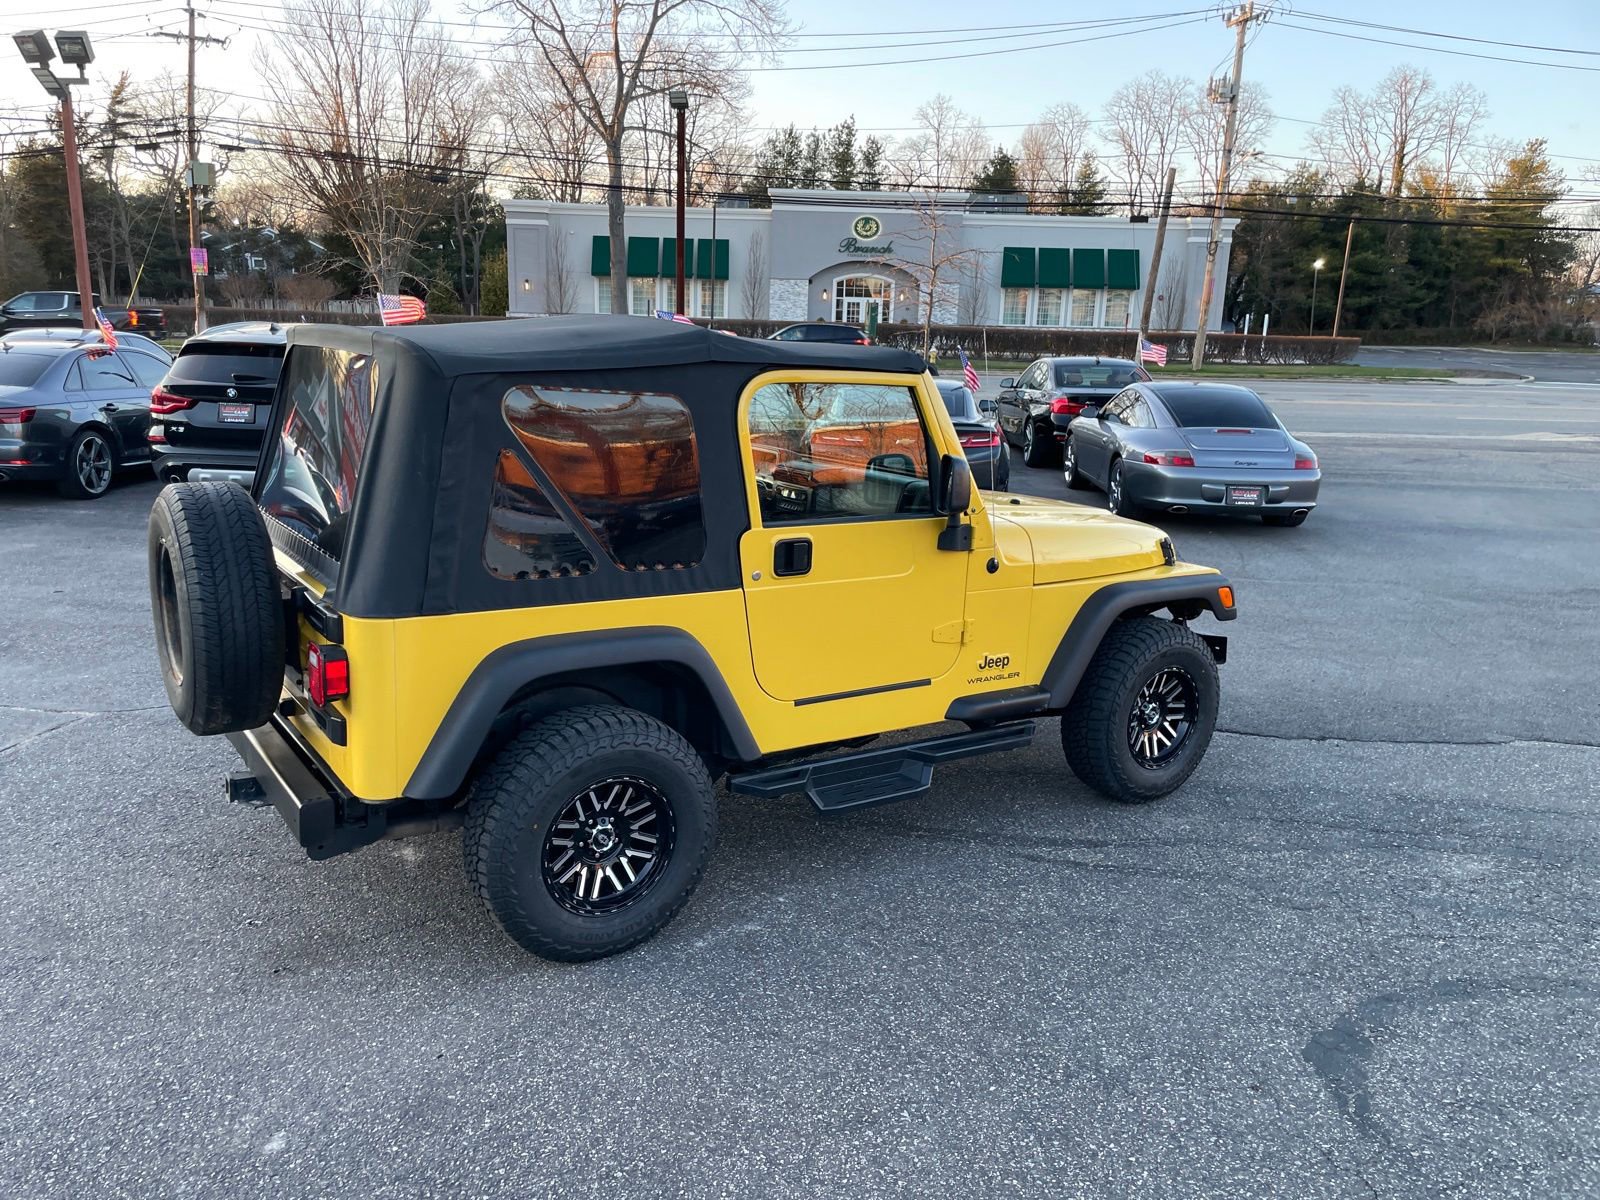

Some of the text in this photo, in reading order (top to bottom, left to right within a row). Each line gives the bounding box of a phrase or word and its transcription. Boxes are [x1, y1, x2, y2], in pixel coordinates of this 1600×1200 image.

[838, 238, 894, 253] Branch
[979, 655, 1010, 670] Jeep
[967, 671, 1020, 685] WRANGLER
